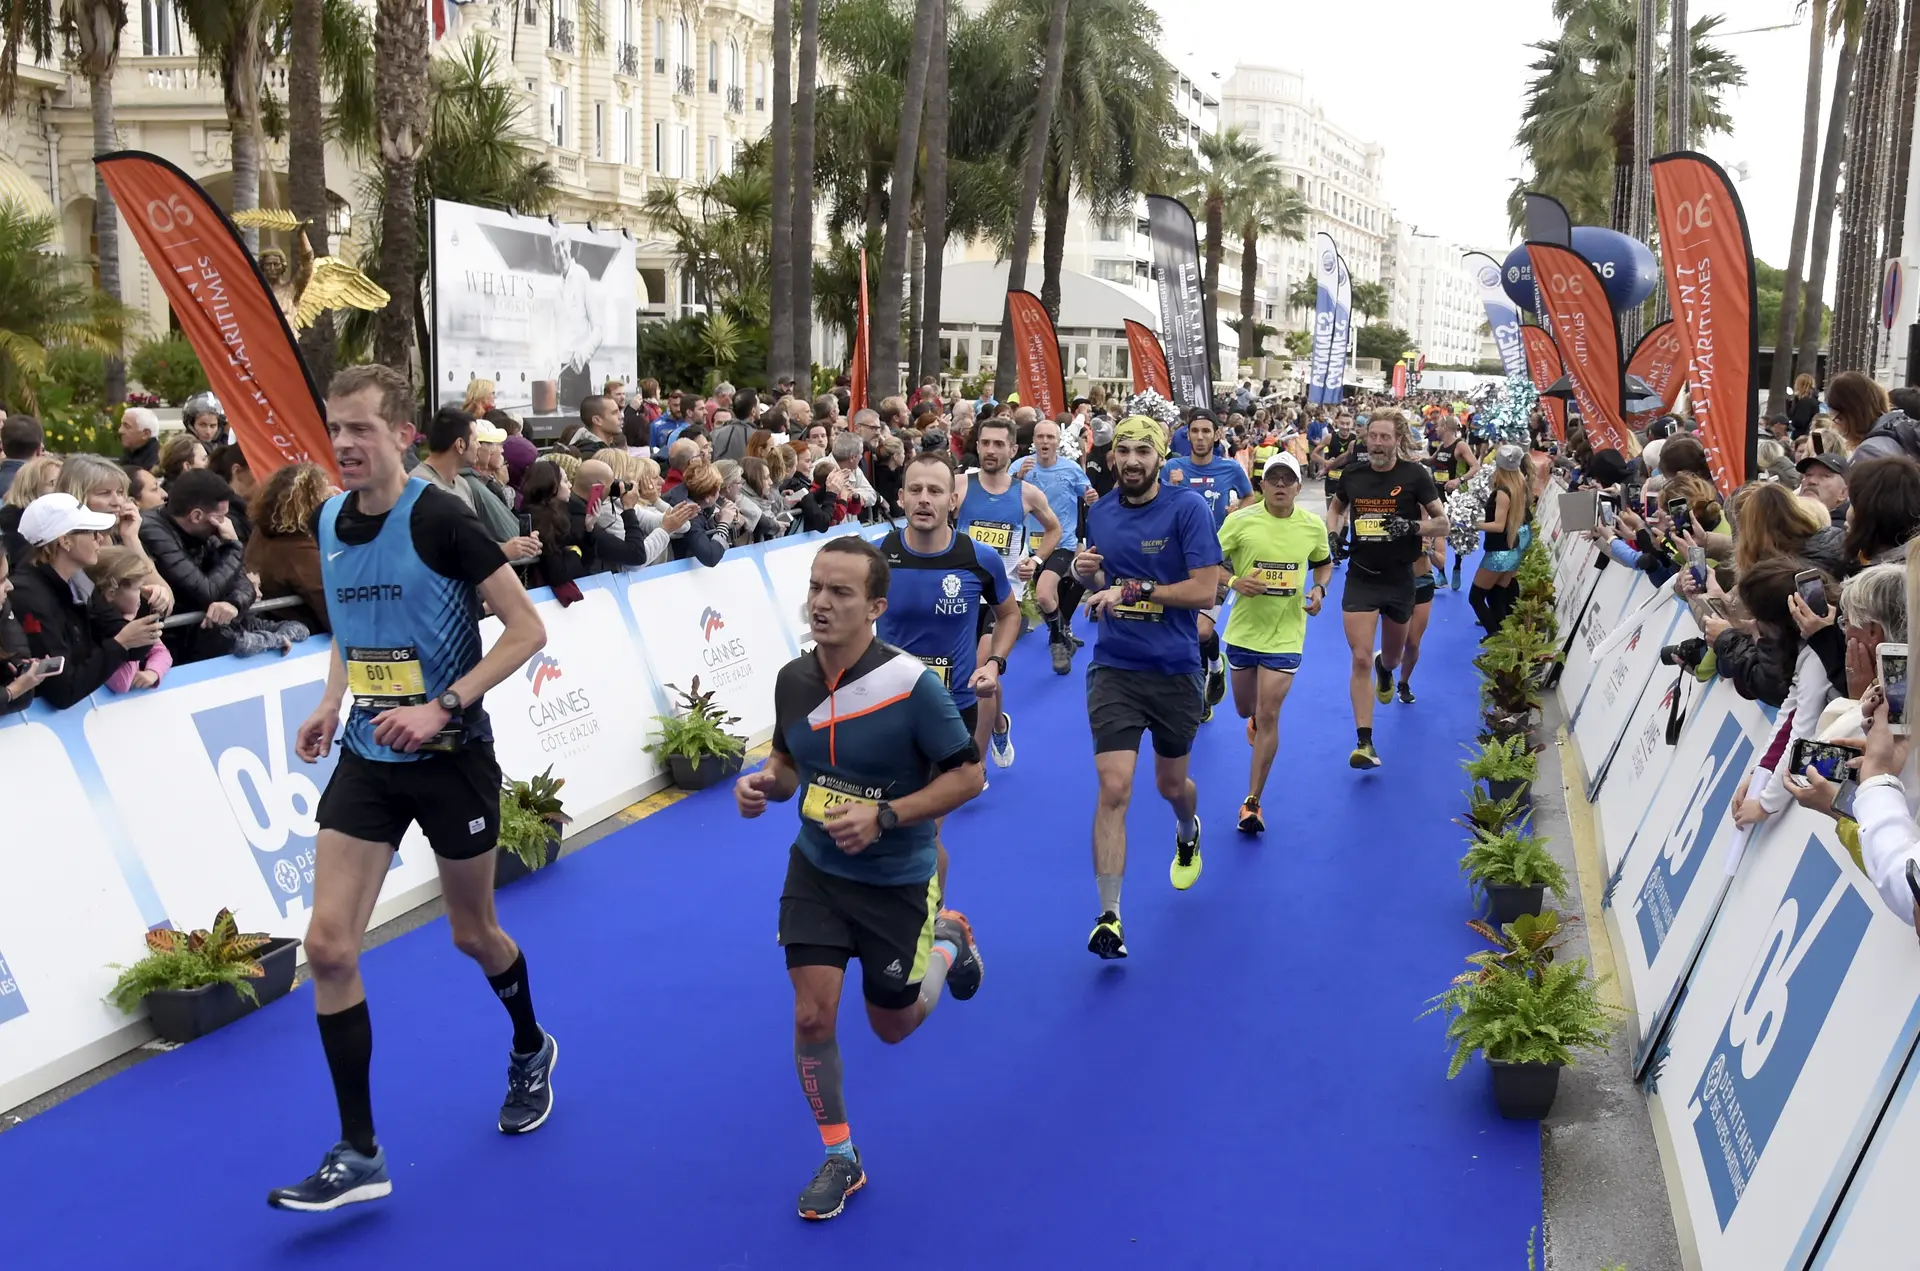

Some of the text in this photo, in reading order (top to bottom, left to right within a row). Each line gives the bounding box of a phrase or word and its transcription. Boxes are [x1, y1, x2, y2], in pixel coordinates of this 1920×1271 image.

[147, 194, 194, 233] 06
[1677, 193, 1712, 234] 06
[466, 270, 535, 299] WHAT'S
[1552, 274, 1584, 295] 06
[1657, 334, 1680, 351] 06
[1604, 426, 1624, 451] DES
[975, 530, 1005, 545] 6278
[1266, 571, 1283, 580] 984
[336, 585, 402, 603] SPARTA
[935, 603, 968, 615] NICE
[392, 650, 410, 660] 06
[703, 638, 746, 667] CANNES
[935, 657, 948, 666] 06
[366, 665, 393, 681] 601
[713, 671, 732, 688] CÔTE
[528, 688, 590, 728] CANNES
[541, 719, 601, 753] CÔTE d'AZUR
[865, 786, 882, 799] 06
[1719, 1071, 1758, 1177] DÉPARTEMENT
